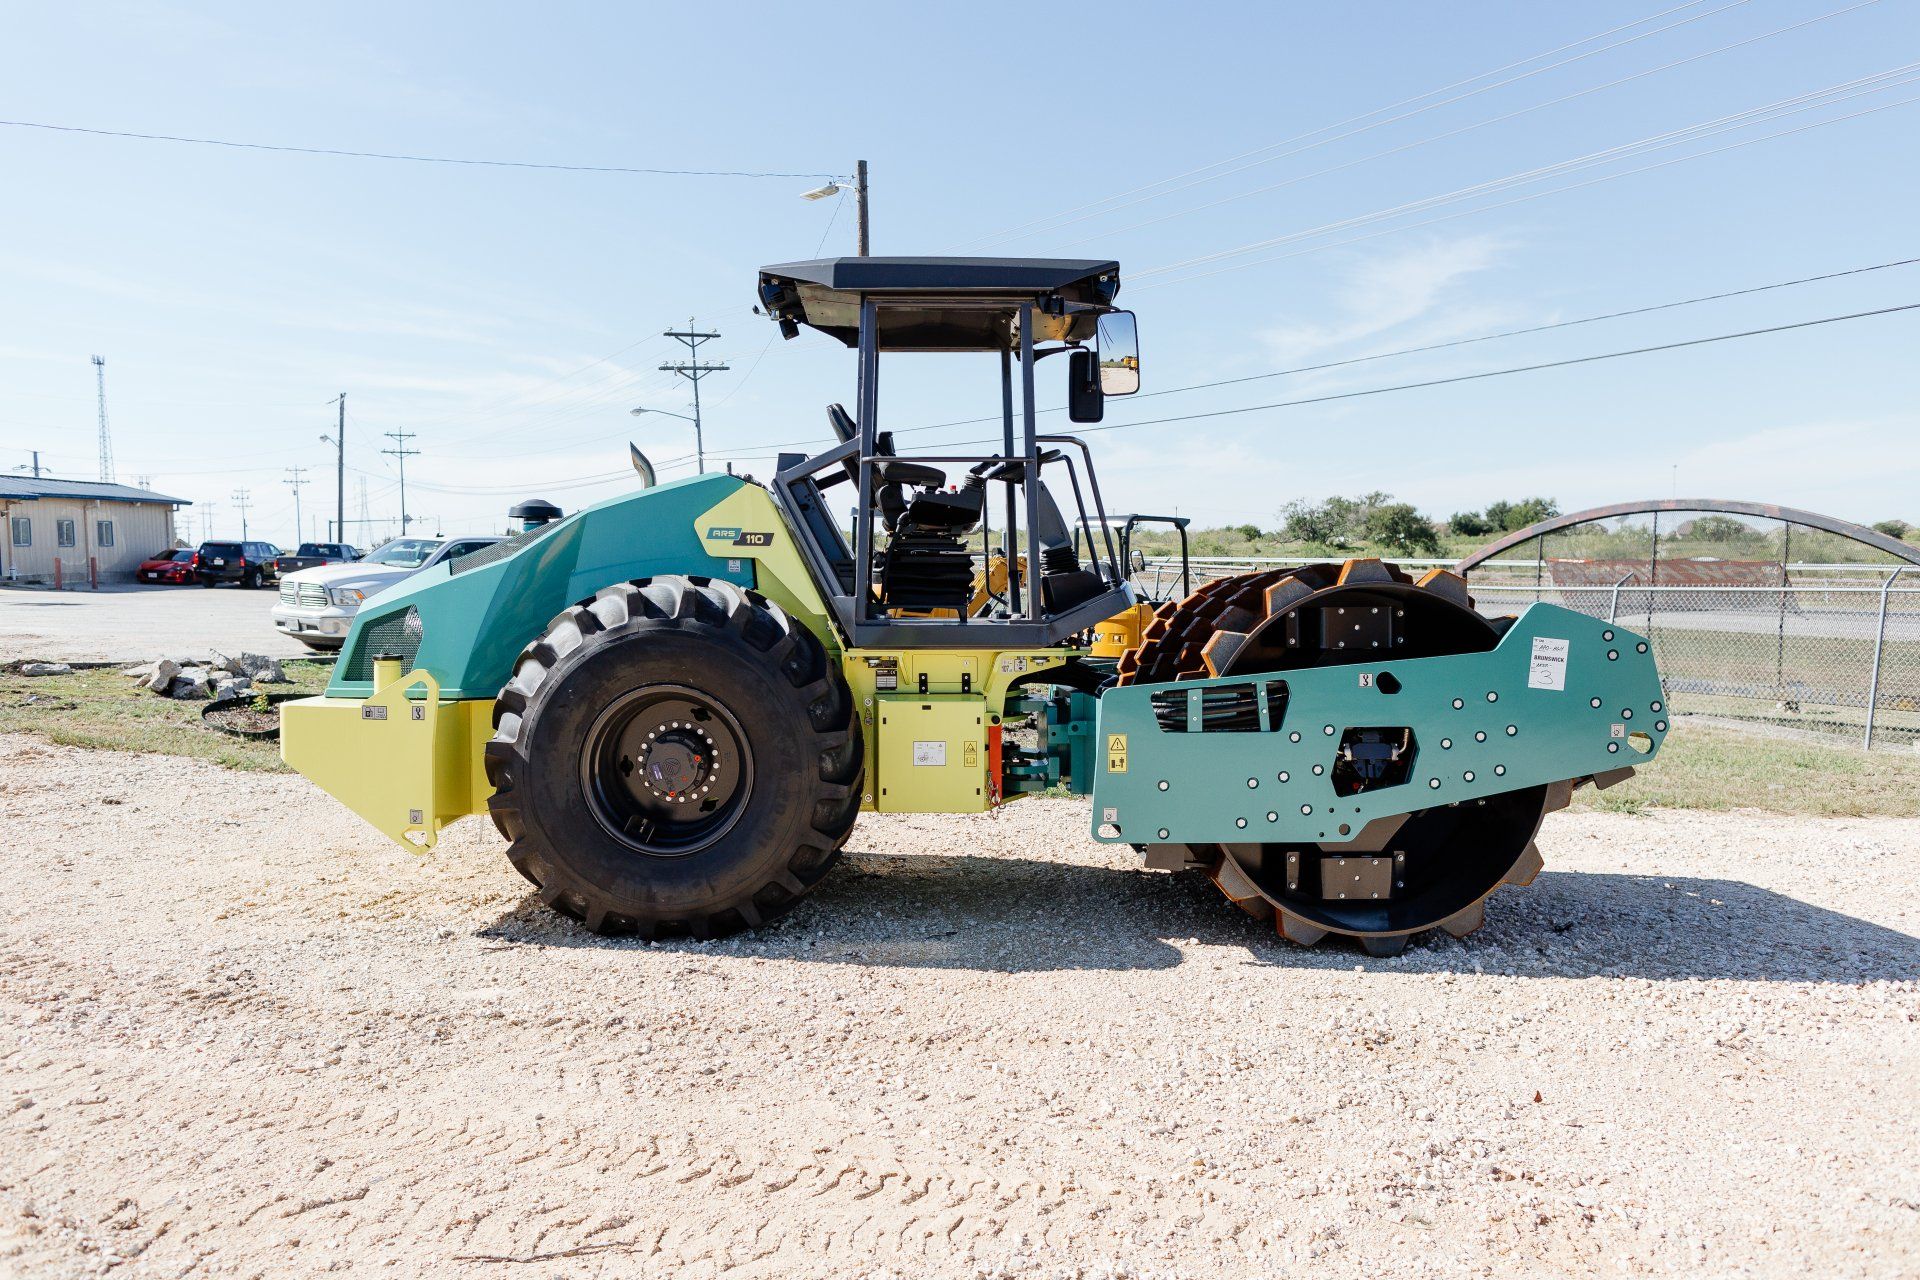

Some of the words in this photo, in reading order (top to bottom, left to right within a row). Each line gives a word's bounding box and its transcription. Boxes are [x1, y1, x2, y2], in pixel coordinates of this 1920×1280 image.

[746, 534, 764, 544] 110
[1533, 654, 1565, 663] BRUNSWICK
[1537, 669, 1554, 685] 3
